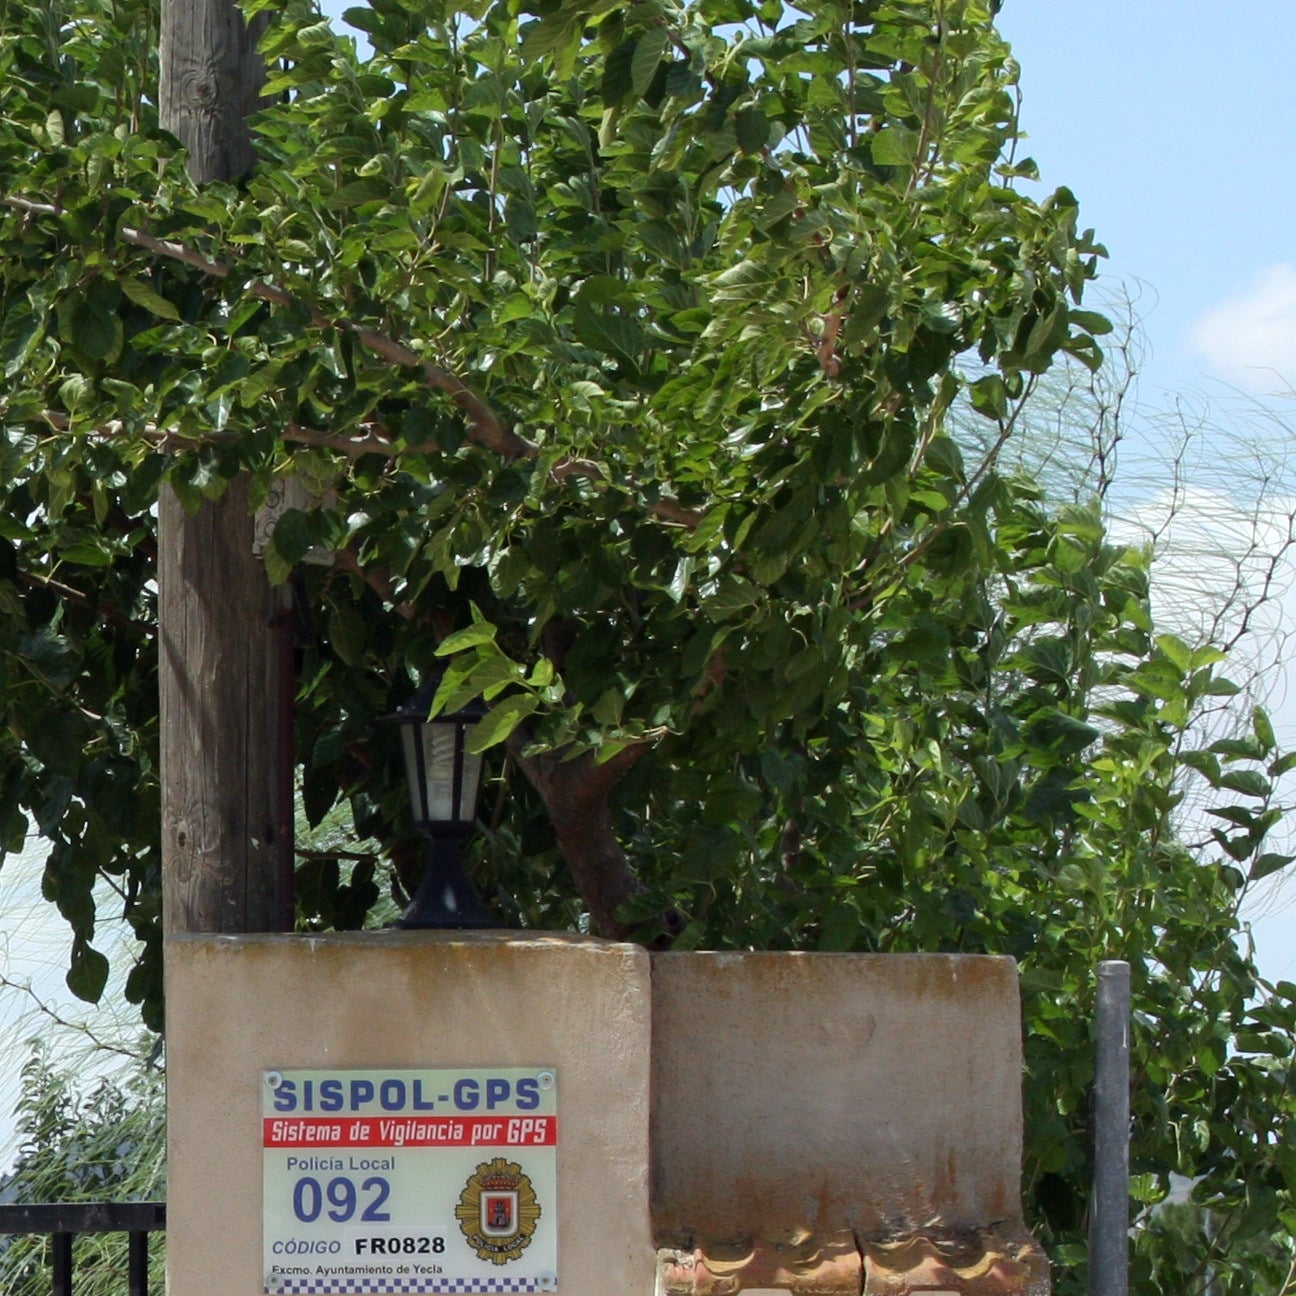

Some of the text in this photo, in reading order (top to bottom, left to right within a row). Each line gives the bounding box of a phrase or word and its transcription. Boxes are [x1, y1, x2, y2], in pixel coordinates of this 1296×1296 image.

[273, 1078, 540, 1112] SISPOL-GPS
[272, 1119, 547, 1146] Sistema de Vigilancia por GPS
[287, 1156, 395, 1170] Policía Local
[293, 1176, 391, 1223] 092
[272, 1237, 446, 1255] CÓDIGO FR0828
[272, 1264, 443, 1276] Excmo. Ayuntamiento de Yecla
